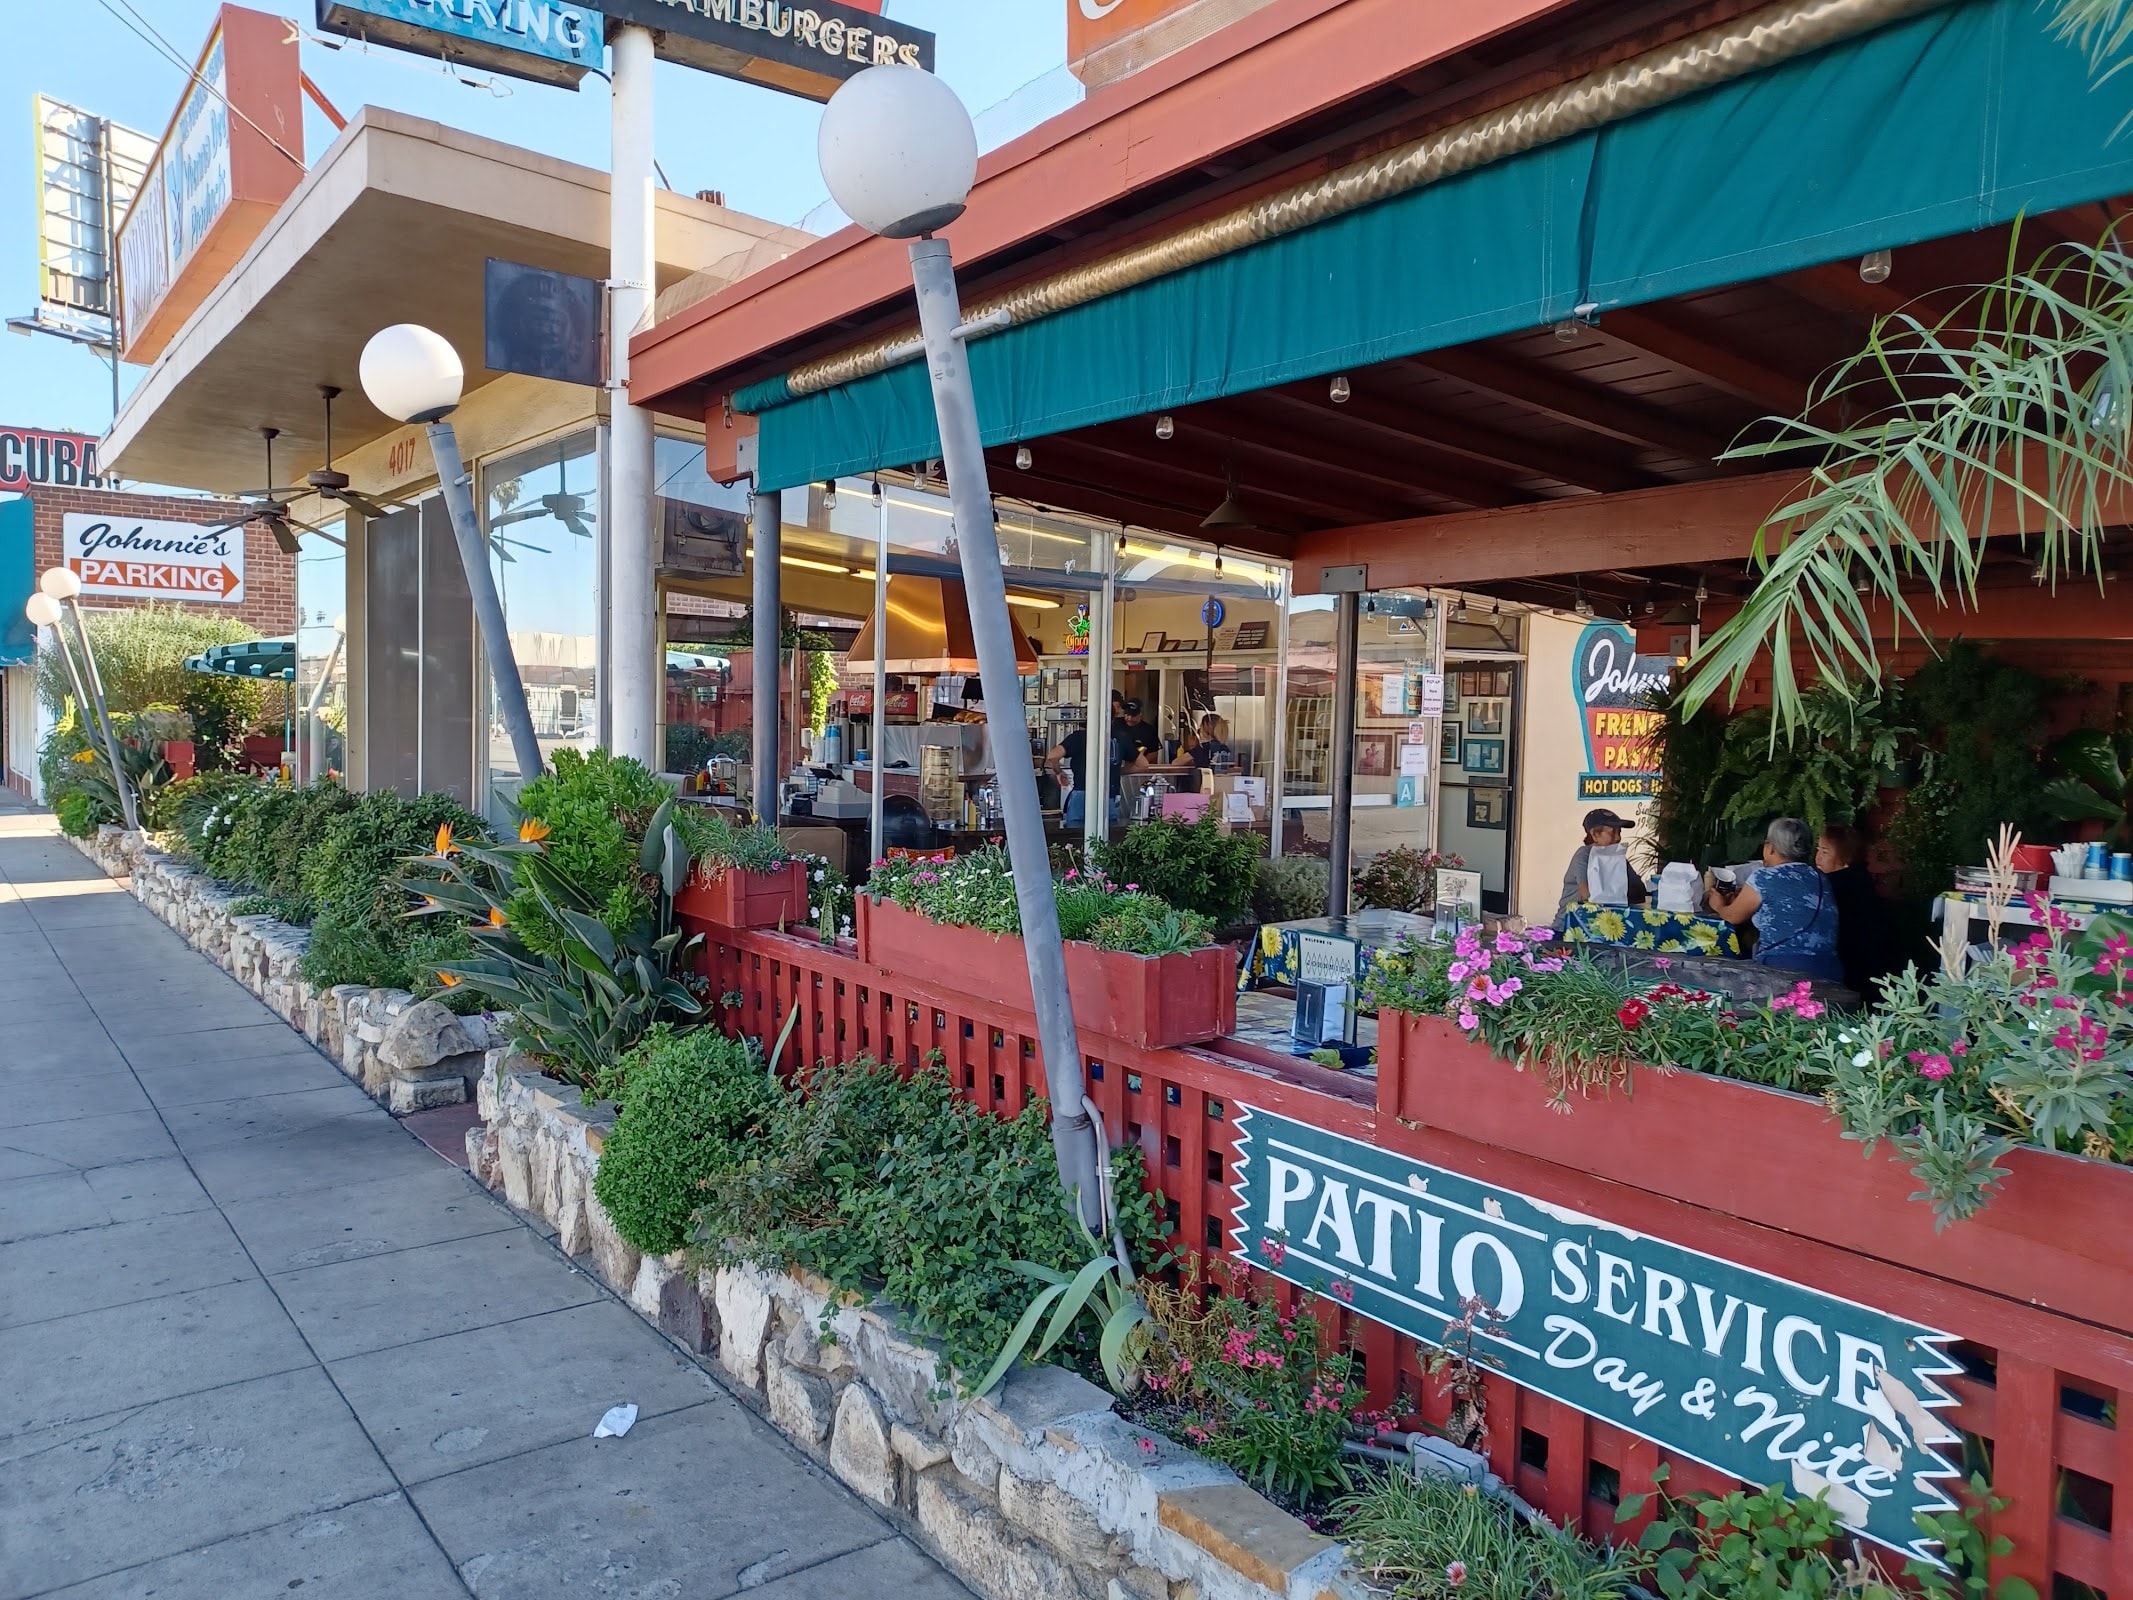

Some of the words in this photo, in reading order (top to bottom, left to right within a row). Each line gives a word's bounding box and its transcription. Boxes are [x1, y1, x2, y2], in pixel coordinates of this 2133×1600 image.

[389, 437, 415, 477] 4017
[79, 523, 231, 557] Johnnie's
[79, 560, 225, 591] PARKING
[1400, 783, 1412, 802] A
[1585, 779, 1609, 793] HOT
[1611, 779, 1642, 793] DOGS
[1264, 1155, 1525, 1323] PATIO
[1551, 1238, 1890, 1418] SERVICE
[1543, 1314, 1667, 1417] Day
[1680, 1377, 1717, 1421] &
[1733, 1386, 1897, 1498] Nite
